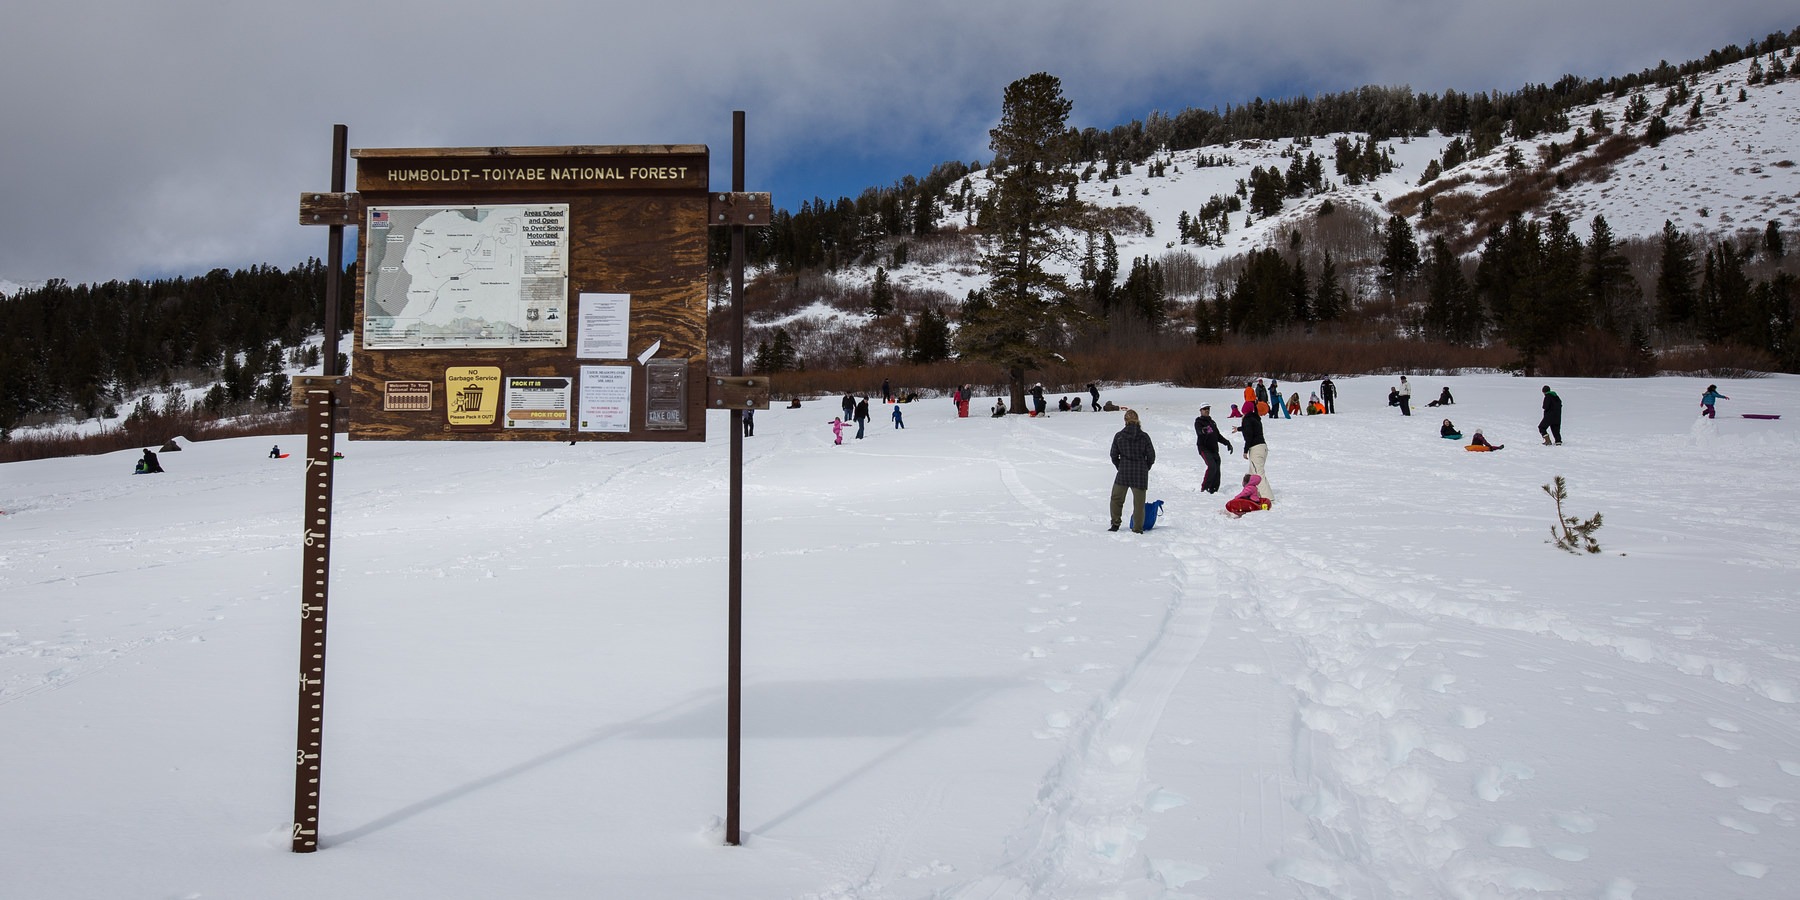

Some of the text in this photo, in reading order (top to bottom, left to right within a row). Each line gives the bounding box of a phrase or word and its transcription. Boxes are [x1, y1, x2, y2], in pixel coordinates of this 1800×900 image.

[551, 167, 625, 180] NATIONAL
[630, 167, 688, 180] FOREST
[649, 411, 680, 420] TAKE ONE
[305, 458, 315, 472] 7
[304, 528, 313, 546] 6
[301, 603, 310, 619] 5
[299, 673, 308, 691] 4
[297, 750, 305, 765] 3
[293, 823, 302, 840] 2
